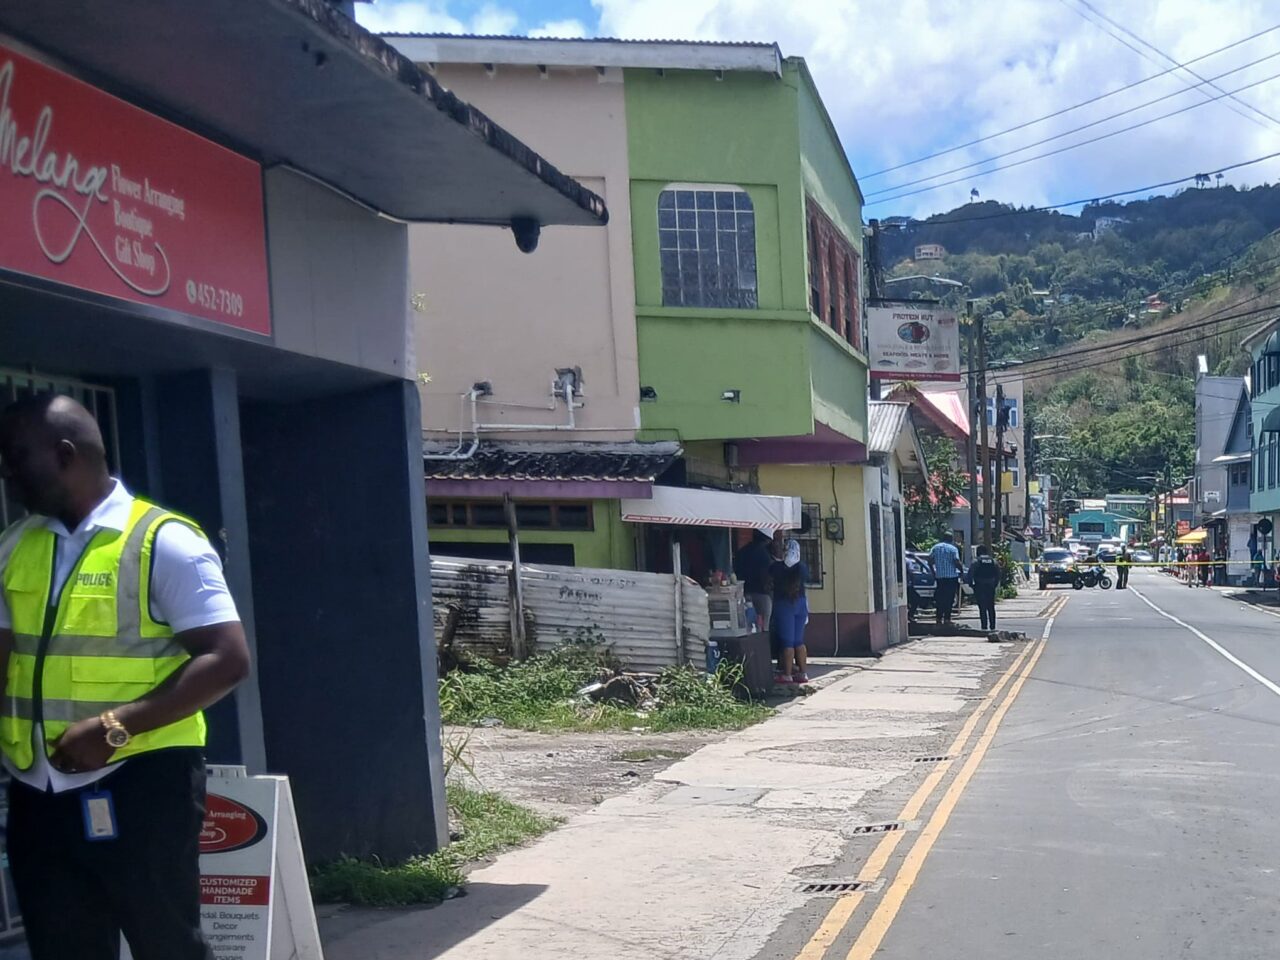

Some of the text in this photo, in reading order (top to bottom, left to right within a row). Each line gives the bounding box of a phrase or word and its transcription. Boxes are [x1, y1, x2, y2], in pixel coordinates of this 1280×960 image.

[111, 164, 185, 221] Flower Arranging
[114, 199, 152, 239] Boutique
[115, 235, 155, 276] Gift Shop
[198, 282, 244, 317] 452-7309
[75, 572, 113, 586] POLICE
[209, 810, 247, 820] Arranging
[200, 829, 216, 838] hop
[200, 878, 257, 886] CUSTOMIZED
[202, 887, 253, 895] HANDMADE
[220, 911, 260, 921] Bouquets
[213, 922, 238, 930] Decor
